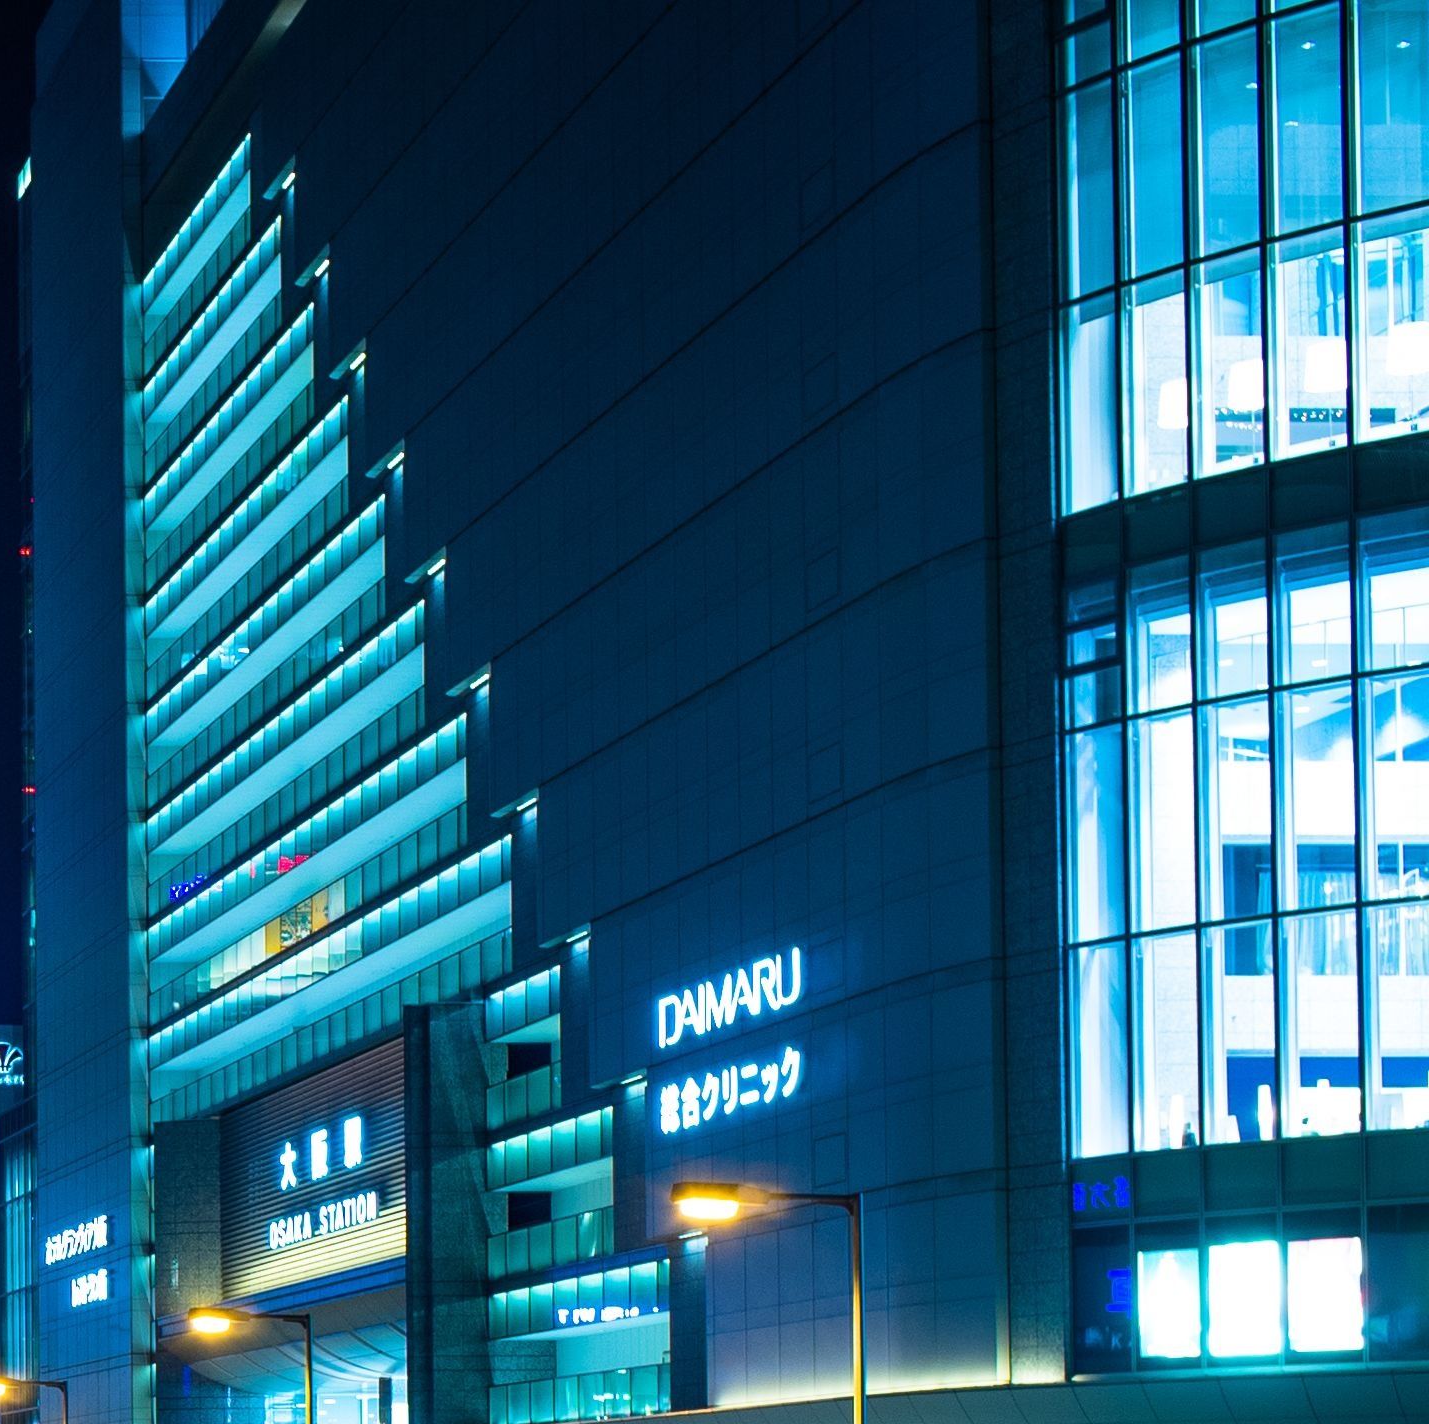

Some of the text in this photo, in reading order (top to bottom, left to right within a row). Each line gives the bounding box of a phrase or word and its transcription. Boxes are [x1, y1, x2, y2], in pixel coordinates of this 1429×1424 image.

[658, 946, 801, 1049] DAIMARU
[660, 1046, 801, 1135] 総合クリニック
[269, 1191, 377, 1250] OSAKA STATION
